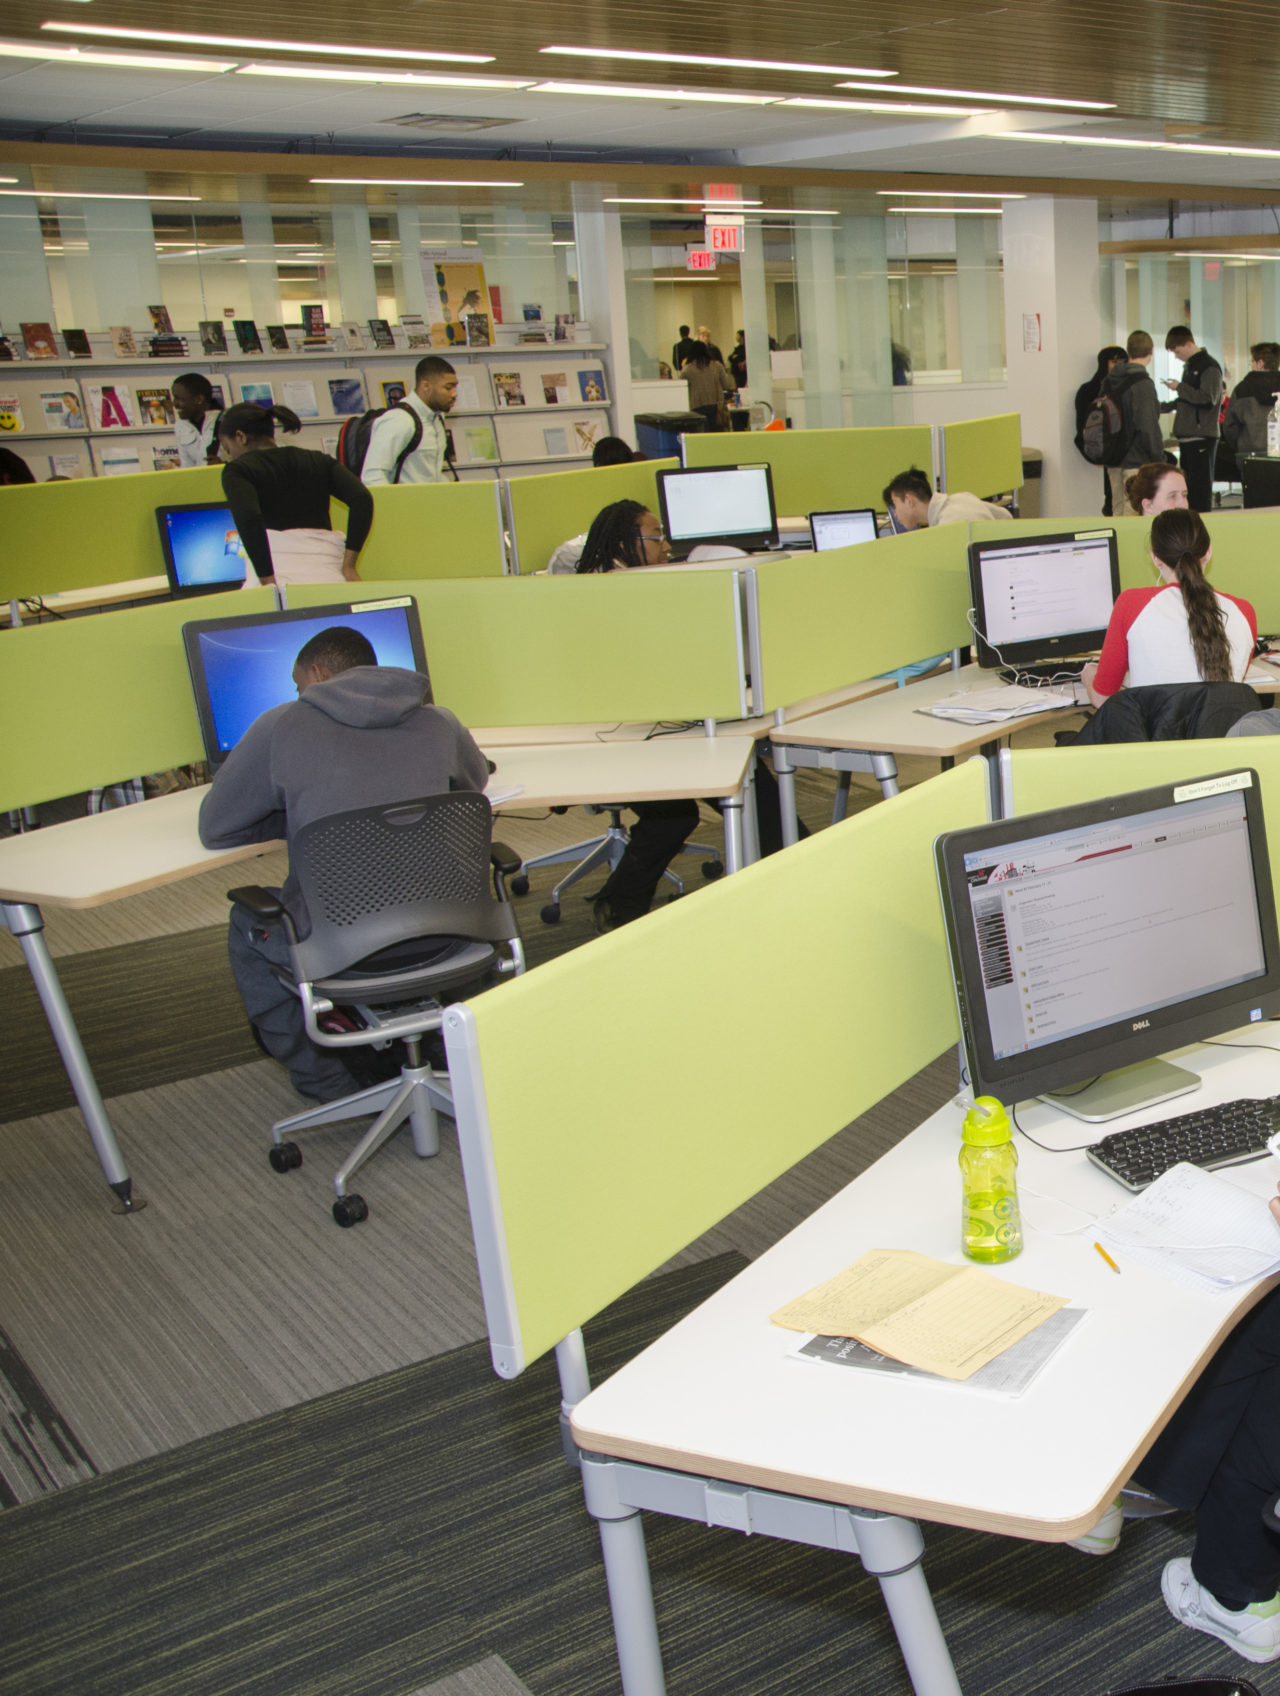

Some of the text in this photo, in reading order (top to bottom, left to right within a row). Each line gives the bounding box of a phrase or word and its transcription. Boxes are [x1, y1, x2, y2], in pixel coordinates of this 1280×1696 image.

[713, 227, 738, 249] EXIT
[691, 250, 711, 269] EXIT
[1132, 1019, 1151, 1031] DELL
